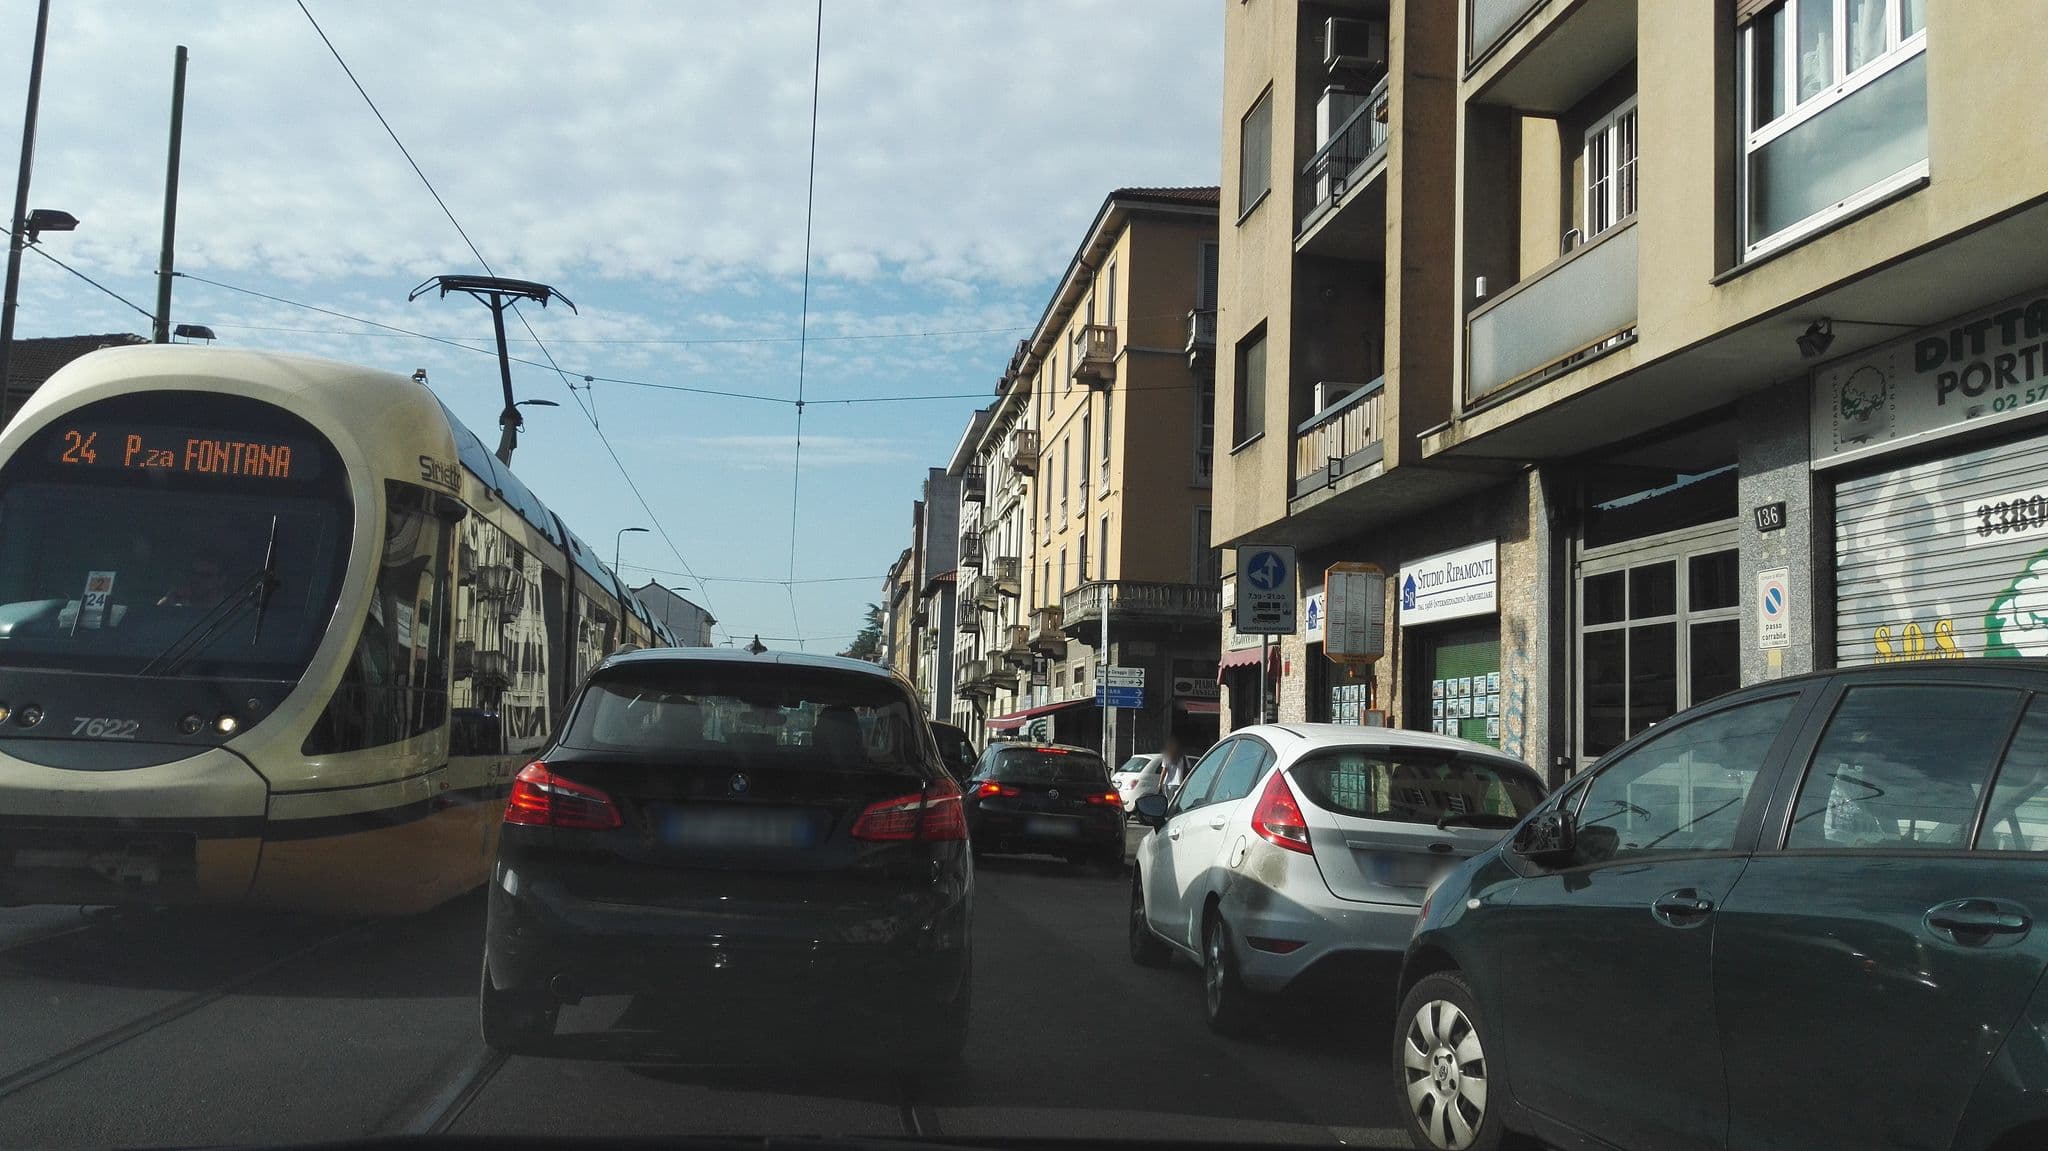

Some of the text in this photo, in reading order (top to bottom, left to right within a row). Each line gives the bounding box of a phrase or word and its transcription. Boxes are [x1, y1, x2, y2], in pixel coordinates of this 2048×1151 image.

[1993, 394, 2018, 412] 02
[62, 430, 292, 478] 24 P.za FONTANA
[1757, 506, 1779, 526] 136
[1976, 494, 2048, 538] 3389
[1417, 558, 1494, 589] STUDIO RIPAMONTI
[87, 593, 105, 607] 24
[1404, 588, 1415, 608] SR
[1765, 623, 1783, 632] passo
[71, 716, 139, 739] 7622
